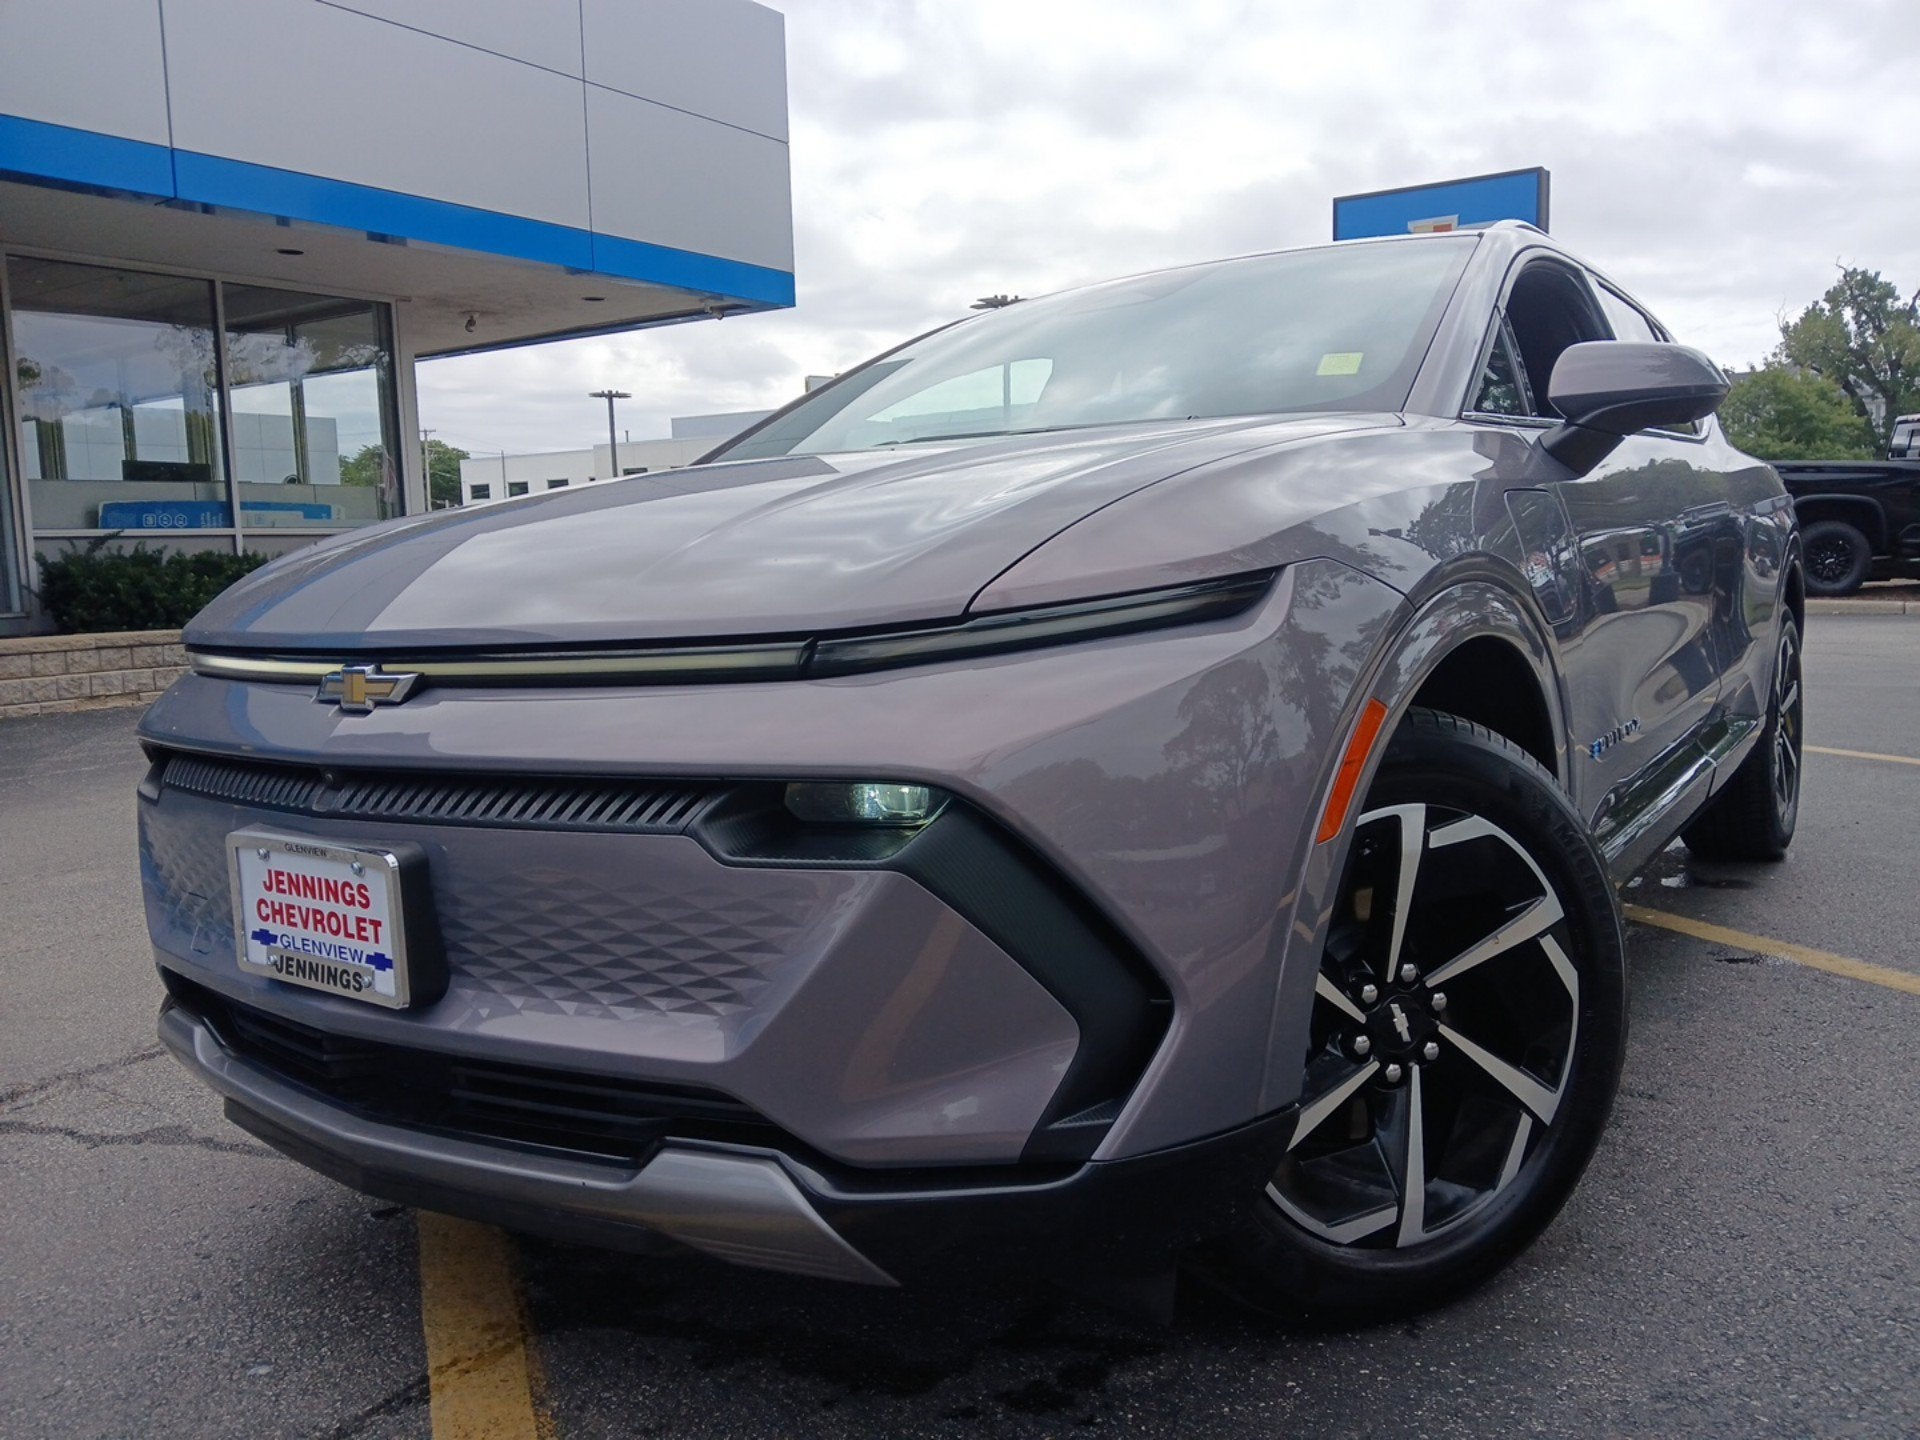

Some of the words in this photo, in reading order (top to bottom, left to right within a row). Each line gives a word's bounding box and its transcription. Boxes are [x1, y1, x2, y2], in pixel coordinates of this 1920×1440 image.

[284, 842, 328, 857] GLENVIEW
[262, 868, 371, 910] JENNINGS
[256, 898, 383, 944] CHEVROLET
[279, 933, 364, 964] GLENVIEW
[275, 954, 364, 993] JENNINGS
